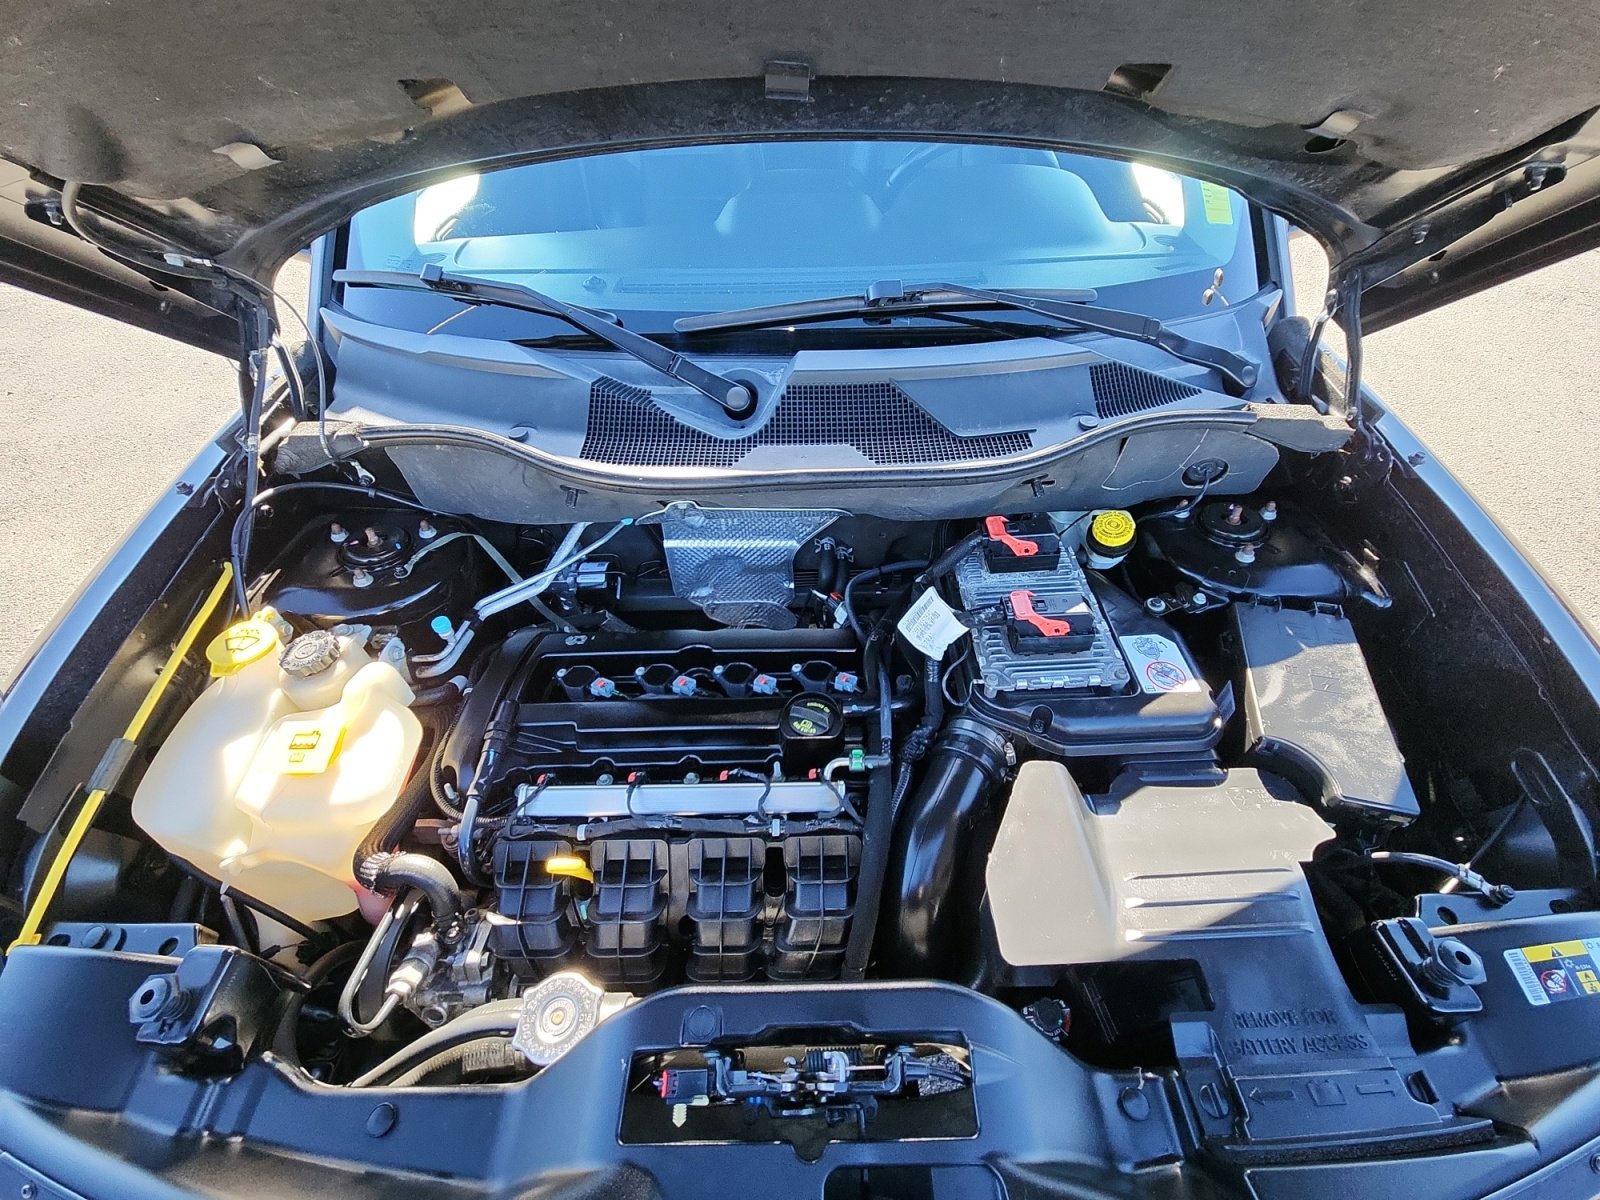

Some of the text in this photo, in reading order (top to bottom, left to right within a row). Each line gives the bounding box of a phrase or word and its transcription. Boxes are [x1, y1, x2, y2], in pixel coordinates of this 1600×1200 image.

[1234, 1008, 1338, 1029] REMOVE FOR
[1230, 1034, 1369, 1056] BATTERY ACCESS
